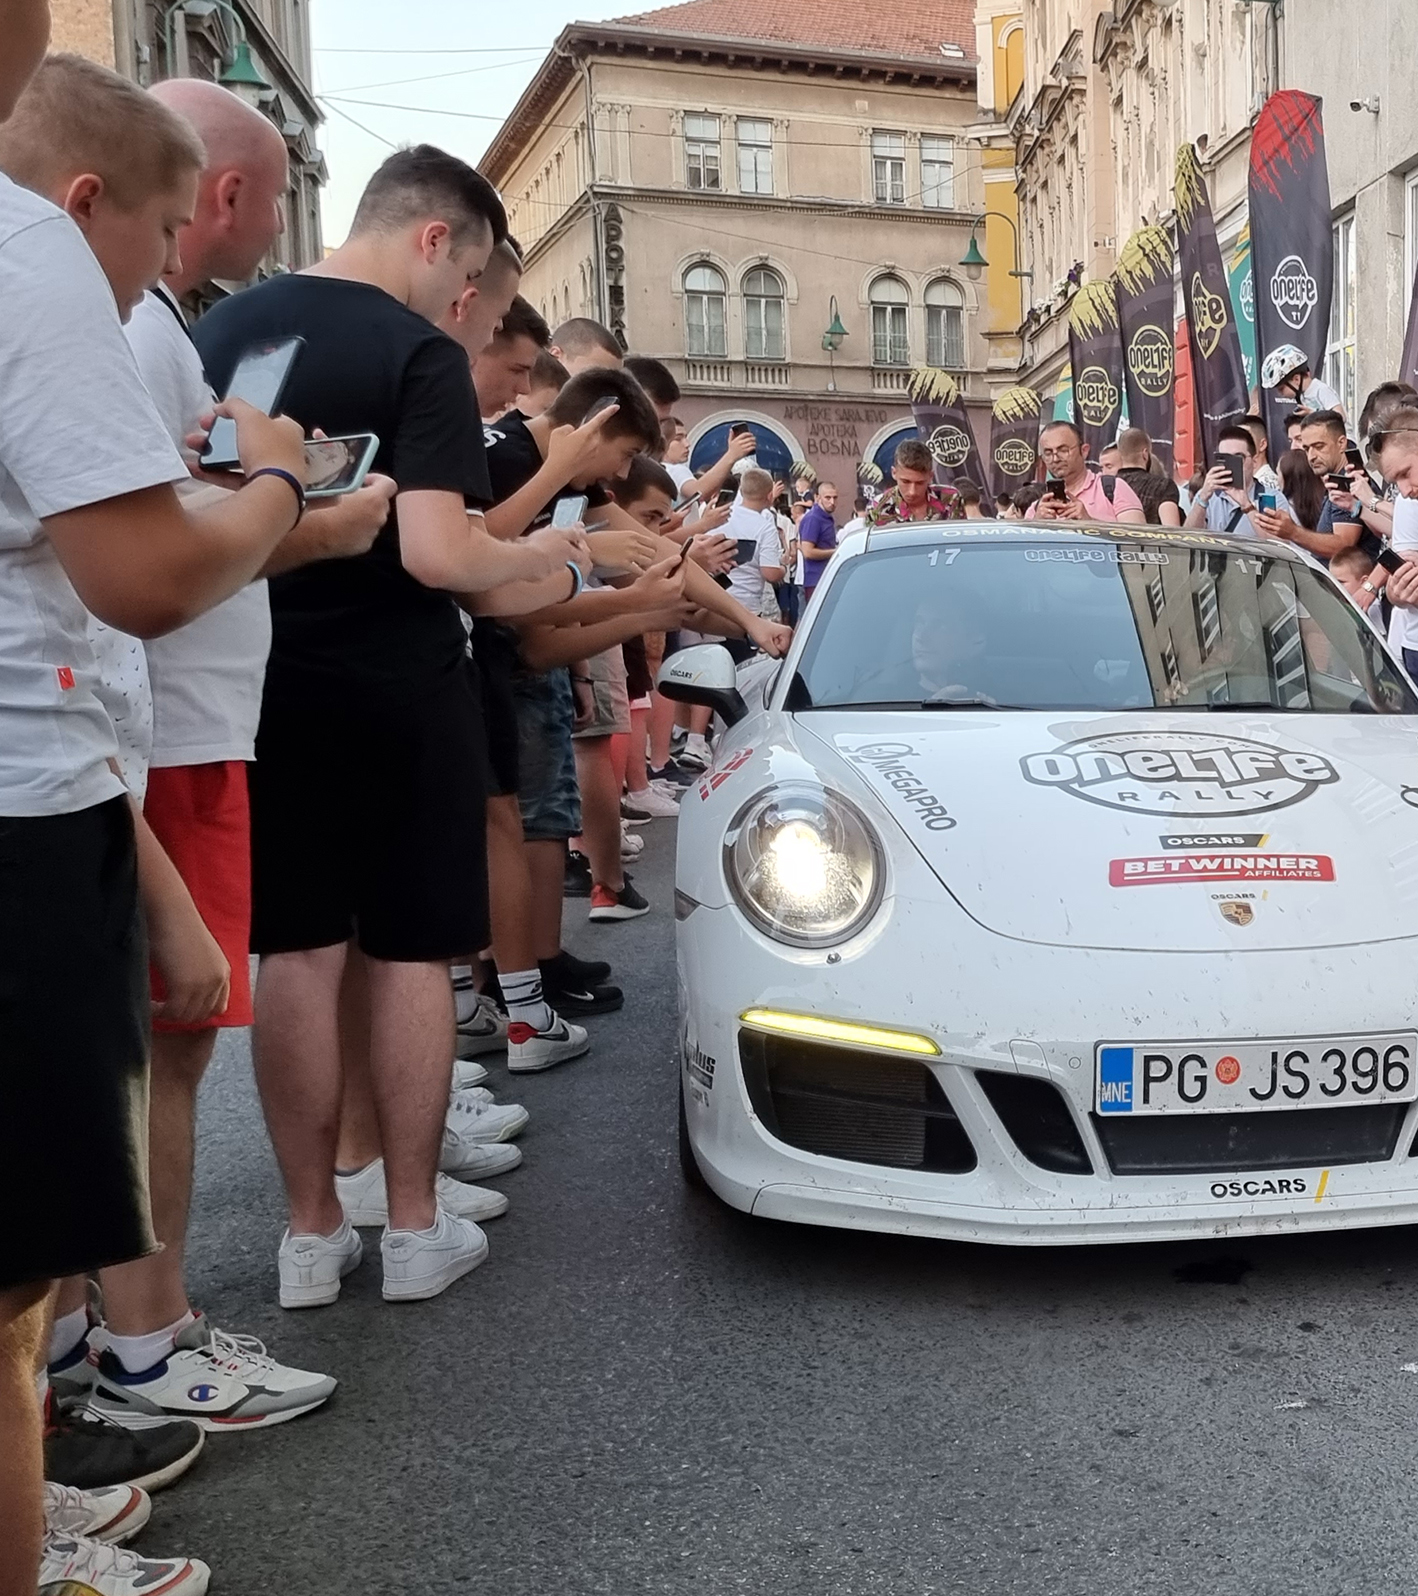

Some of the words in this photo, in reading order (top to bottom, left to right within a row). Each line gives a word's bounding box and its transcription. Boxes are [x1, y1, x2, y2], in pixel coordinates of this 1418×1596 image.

[810, 423, 858, 438] APOTEKA
[807, 438, 861, 457] BOSNA
[1108, 529, 1232, 547] COMPANY
[928, 550, 962, 566] 17
[1235, 558, 1263, 574] 17
[1118, 789, 1274, 802] RALLY
[1167, 836, 1245, 846] OSCARS
[1123, 857, 1318, 874] BETWINNER
[1244, 870, 1321, 878] AFFILIATES
[1101, 1082, 1131, 1102] MNE
[1142, 1053, 1208, 1105] PG
[1210, 1178, 1306, 1198] OSCARS
